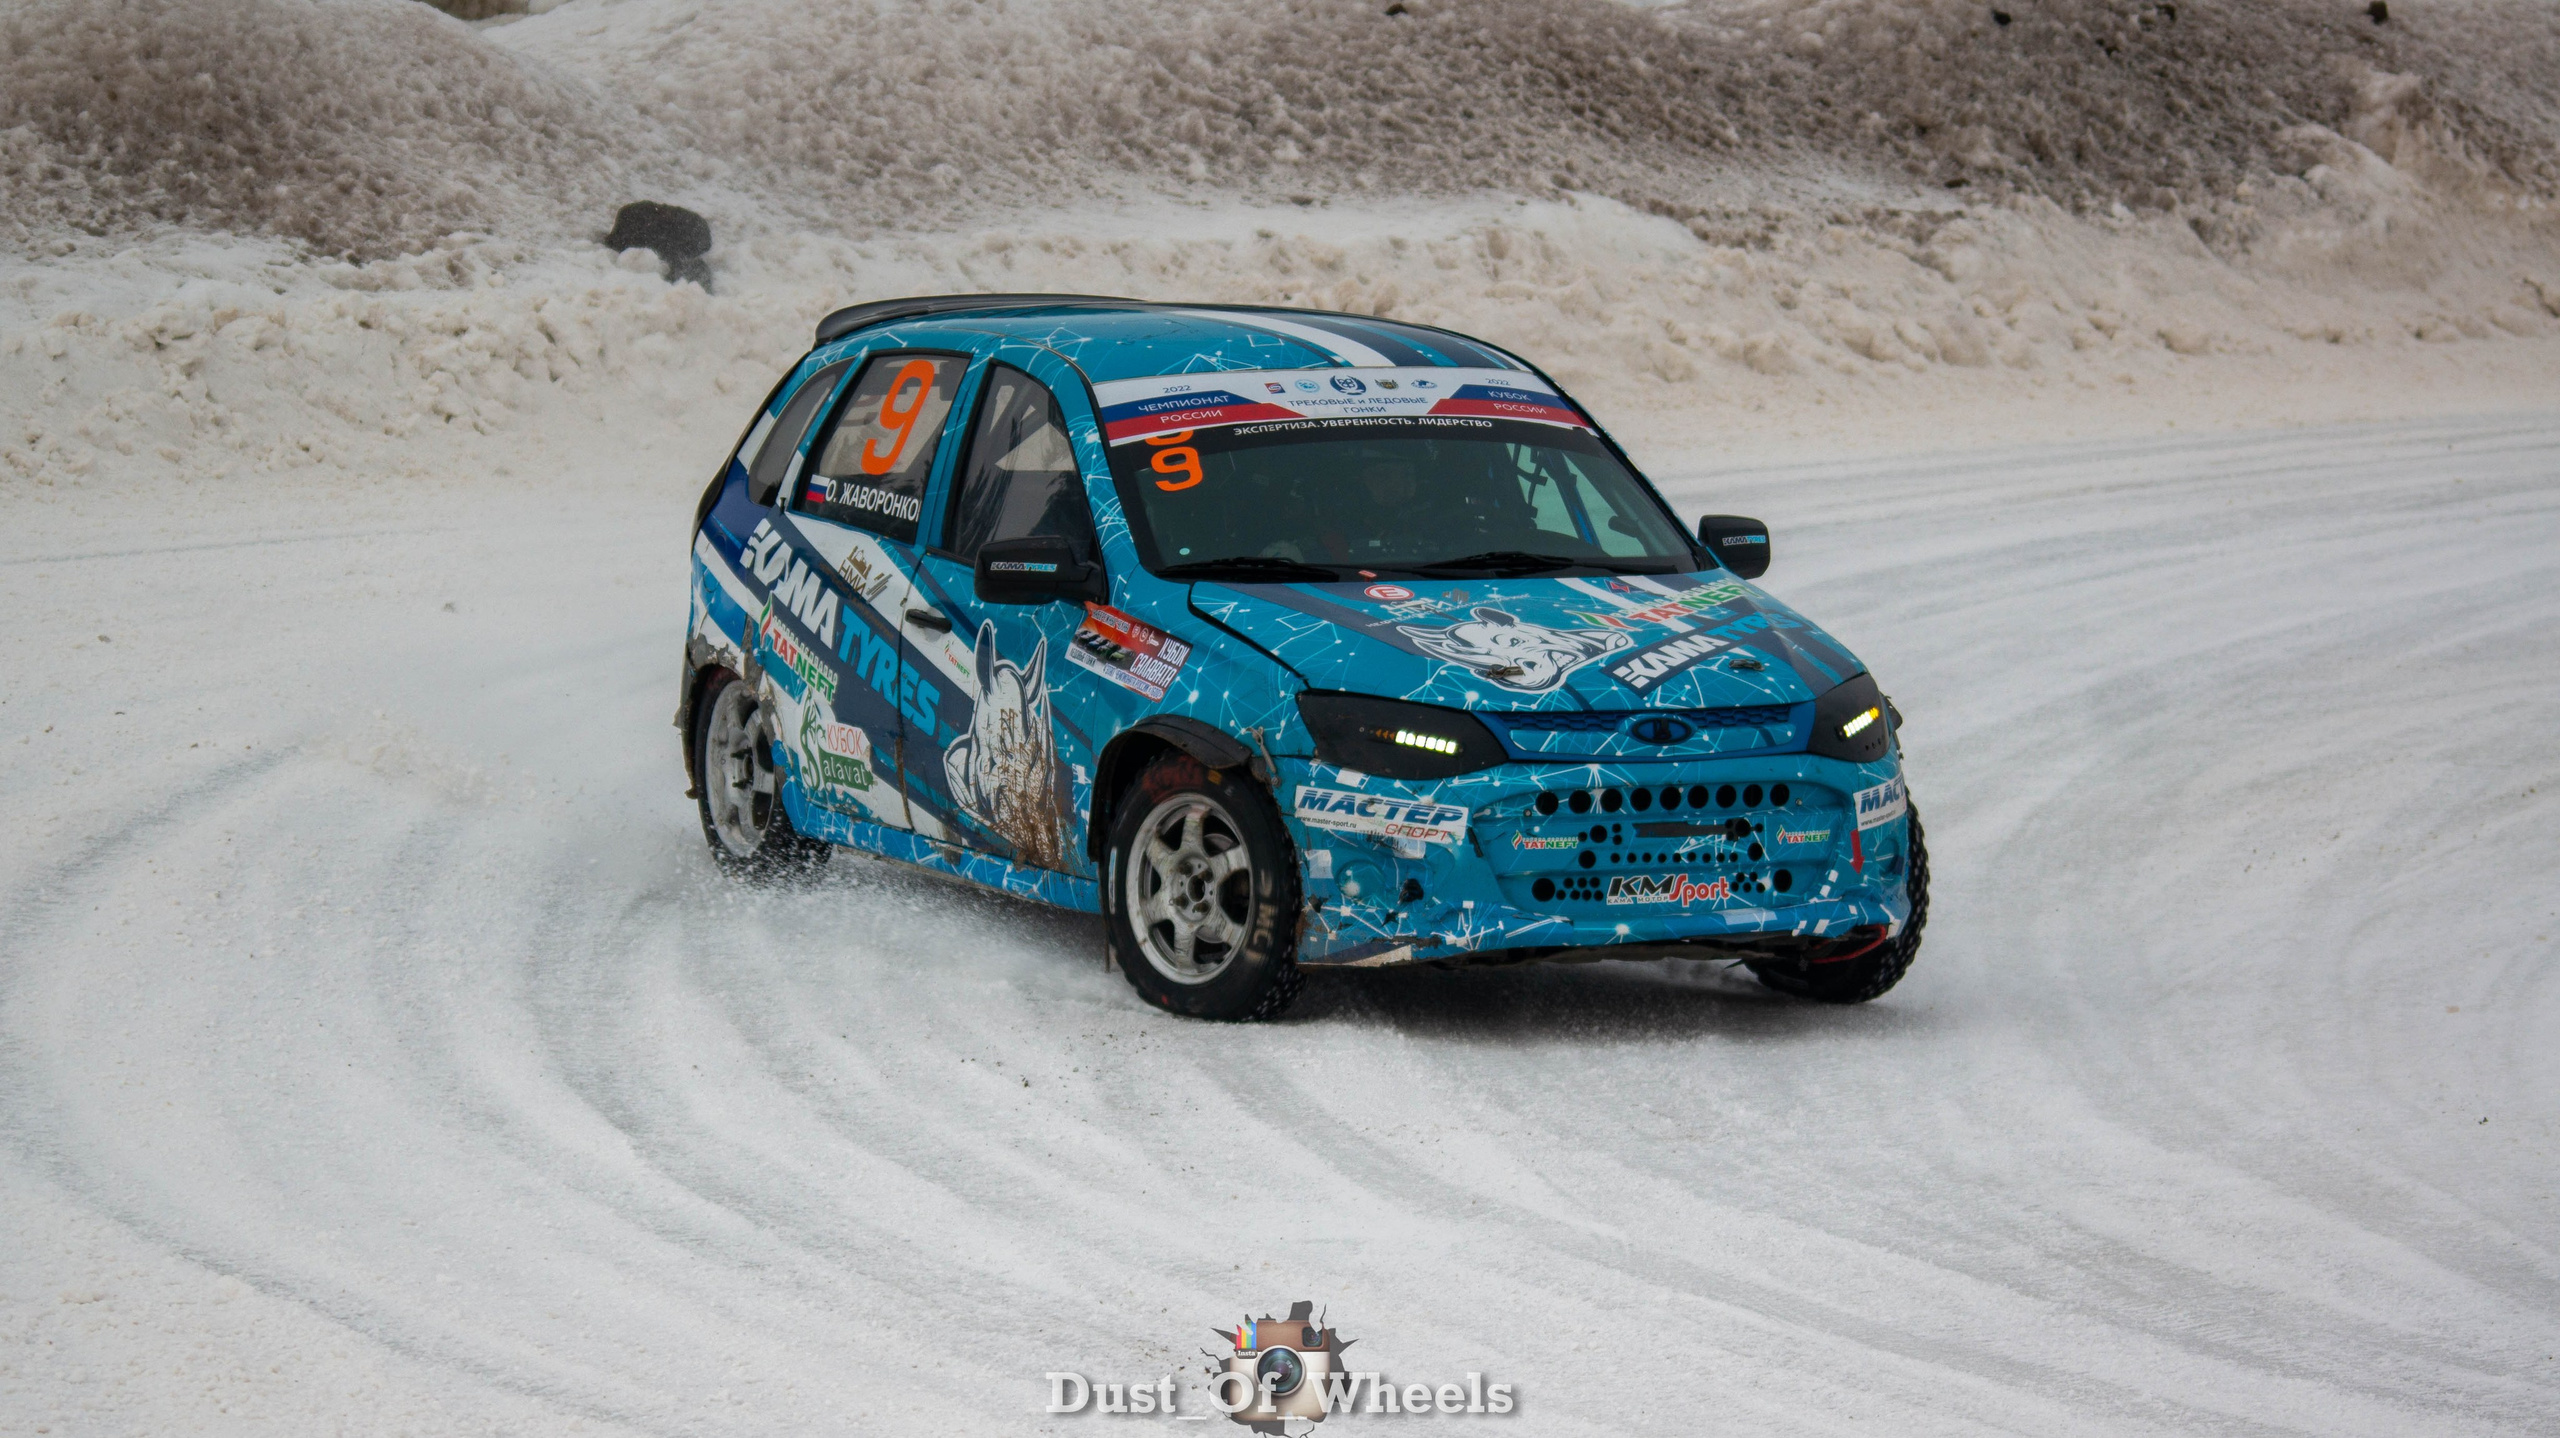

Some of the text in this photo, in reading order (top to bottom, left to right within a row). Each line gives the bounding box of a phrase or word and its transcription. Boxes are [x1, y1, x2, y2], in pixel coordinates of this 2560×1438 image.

[1163, 385, 1191, 394] 2022
[1487, 390, 1532, 401] КУБОК
[1138, 395, 1229, 412] ЧЕМПИОНАТ
[1287, 398, 1355, 407] ТРЕКОВЫЕ
[1368, 397, 1428, 405] ЛЕДОВЫЕ
[1493, 403, 1547, 415] РОССИИ
[860, 359, 935, 476] 9
[1160, 409, 1223, 423] РОССИИ
[1418, 418, 1493, 428] ЛИДЕРСТВО
[1150, 446, 1203, 492] 9
[825, 480, 922, 523] О. ЖАВОРОНКО
[1157, 637, 1190, 667] КУБОК
[773, 627, 835, 704] TATNEFT
[948, 653, 970, 678] TATNEFT
[1130, 652, 1177, 689] САЛАВАТА
[827, 723, 863, 756] КУБОК
[1298, 789, 1463, 826] МАСТЕР
[1385, 823, 1452, 841] СПОРТ
[1787, 833, 1829, 843] TATNEFT
[1523, 840, 1578, 849] TATNEFT
